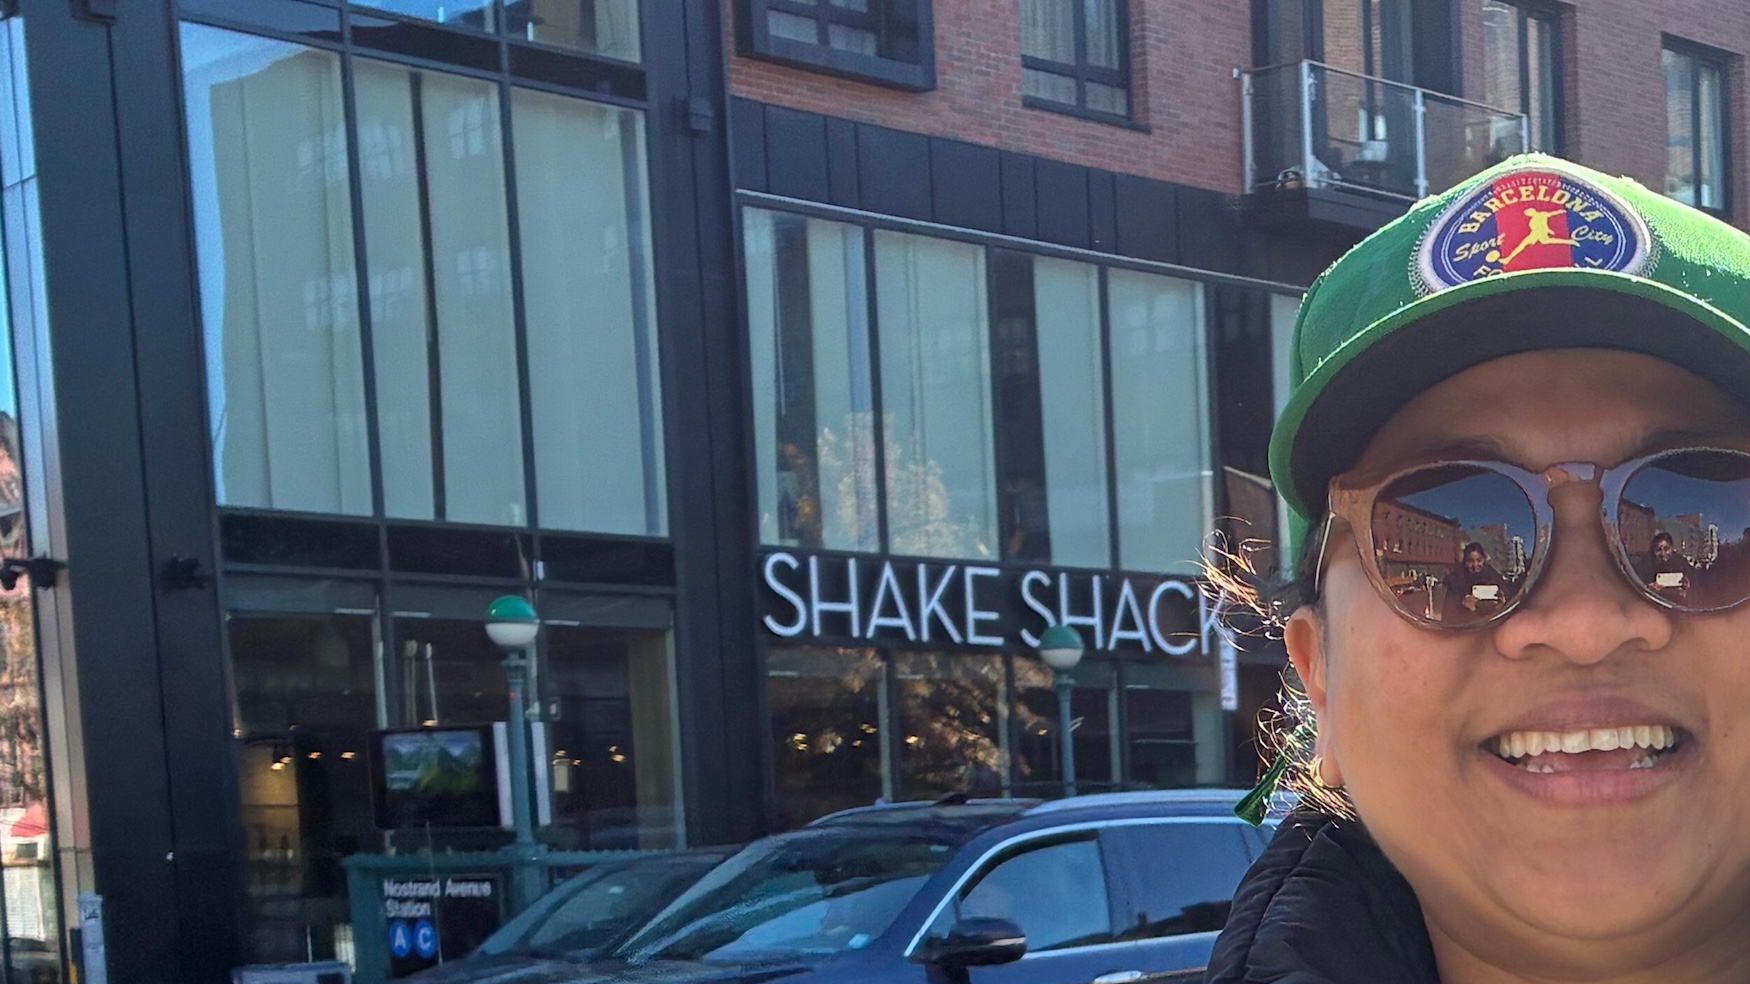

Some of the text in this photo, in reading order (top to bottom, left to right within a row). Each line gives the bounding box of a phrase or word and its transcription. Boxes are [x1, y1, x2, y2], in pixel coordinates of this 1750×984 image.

[1457, 184, 1604, 234] BARCELONA
[1453, 225, 1614, 262] Sport City
[764, 551, 1232, 656] SHAKE SHACK
[384, 878, 491, 898] Nostrand Avenue
[386, 898, 431, 918] Station
[394, 926, 432, 951] A C
